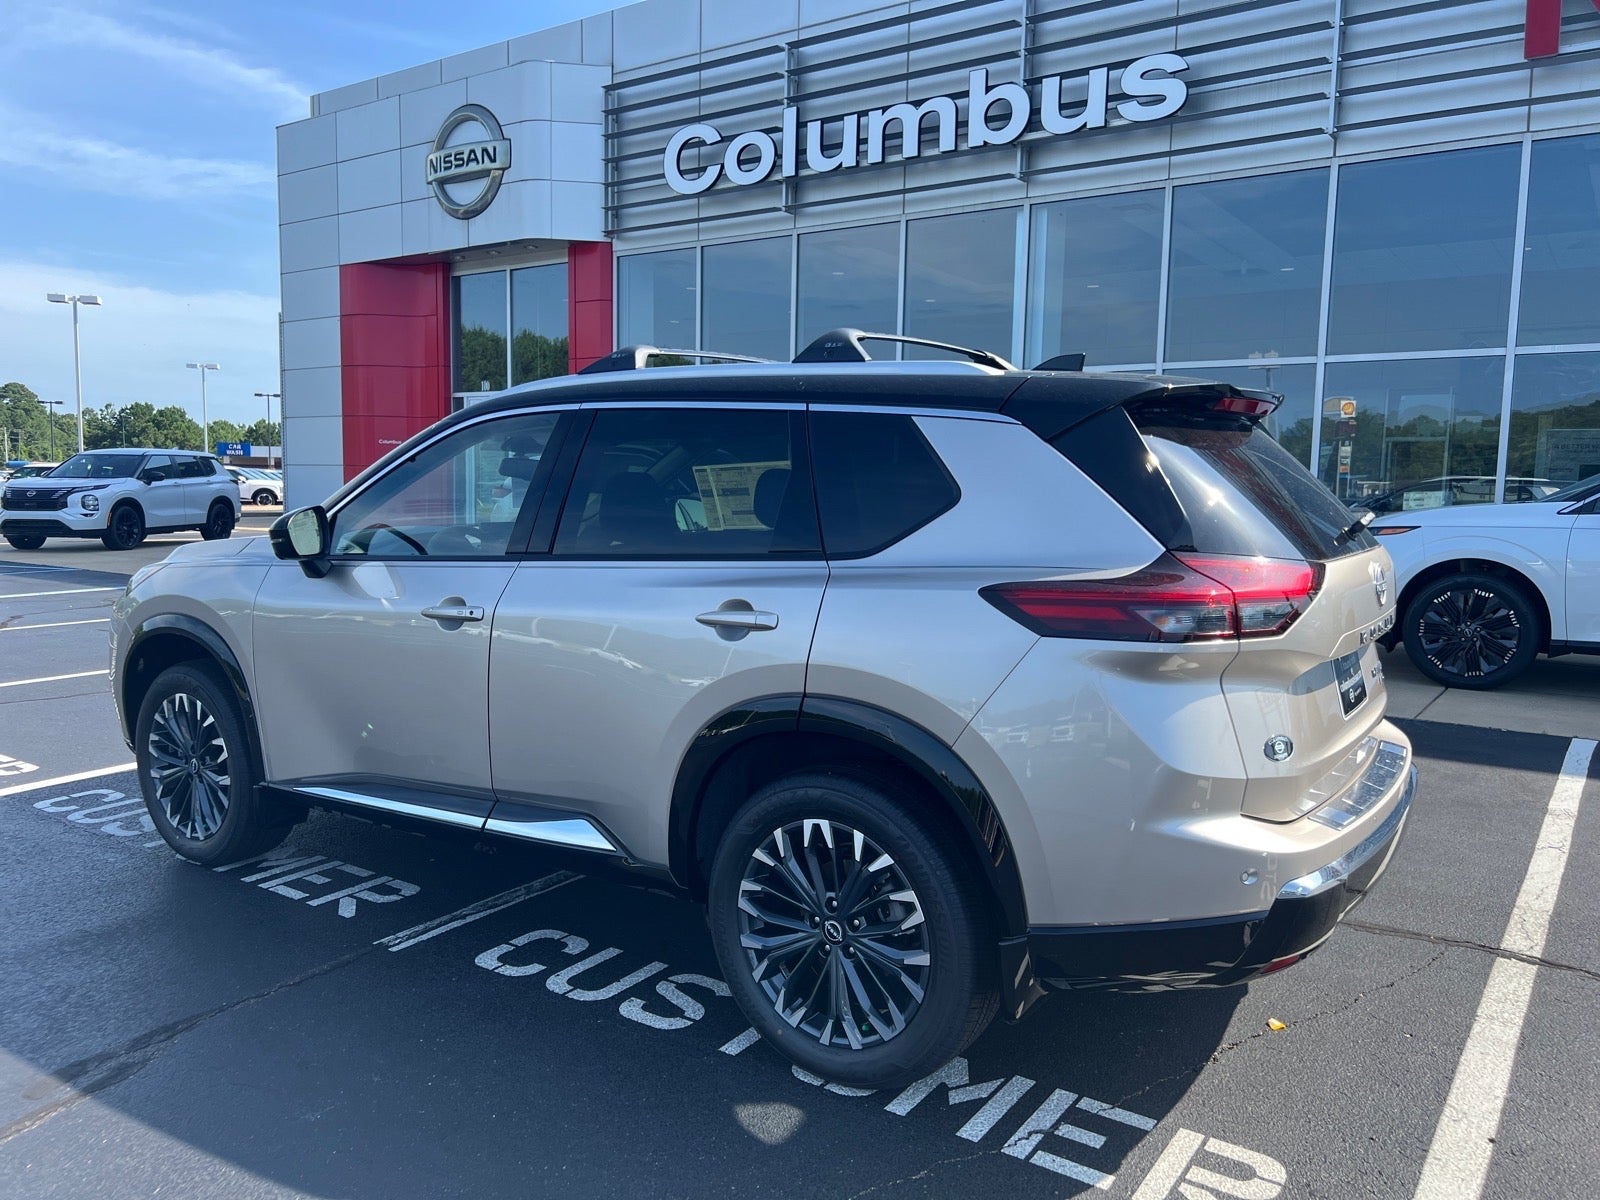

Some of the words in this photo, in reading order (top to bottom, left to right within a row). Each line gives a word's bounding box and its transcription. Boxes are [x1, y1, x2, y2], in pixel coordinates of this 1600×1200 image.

[429, 145, 497, 176] NISSAN
[663, 52, 1190, 195] Columbus
[474, 928, 1288, 1200] CUSMER
